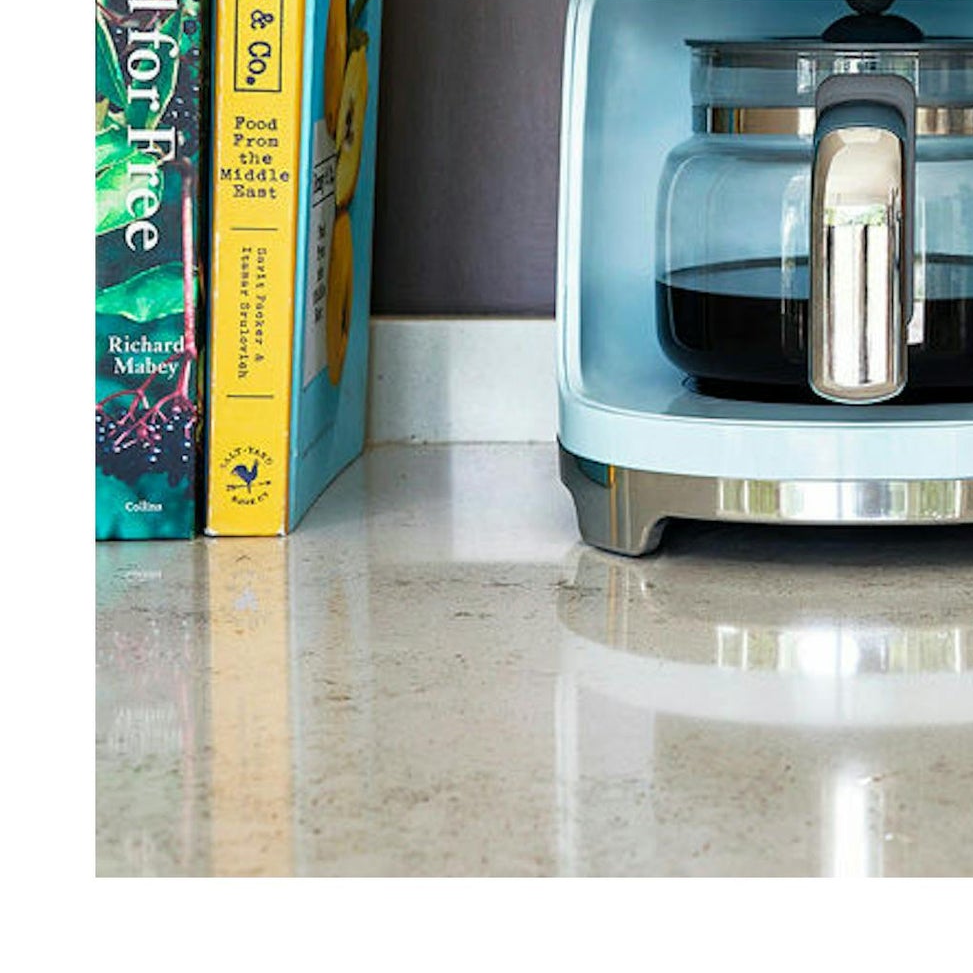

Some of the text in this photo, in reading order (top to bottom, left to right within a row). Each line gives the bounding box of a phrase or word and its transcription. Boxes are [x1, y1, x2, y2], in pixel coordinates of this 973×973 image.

[250, 9, 275, 30] &
[127, 28, 180, 112] for
[245, 41, 272, 86] Co.
[234, 116, 277, 131] Food
[233, 133, 279, 147] From
[240, 151, 272, 165] the
[220, 168, 290, 183] Middle
[124, 124, 177, 251] Free
[233, 184, 277, 199] East
[108, 334, 185, 354] Richard
[114, 357, 180, 380] Mabey
[125, 501, 163, 513] Collins
